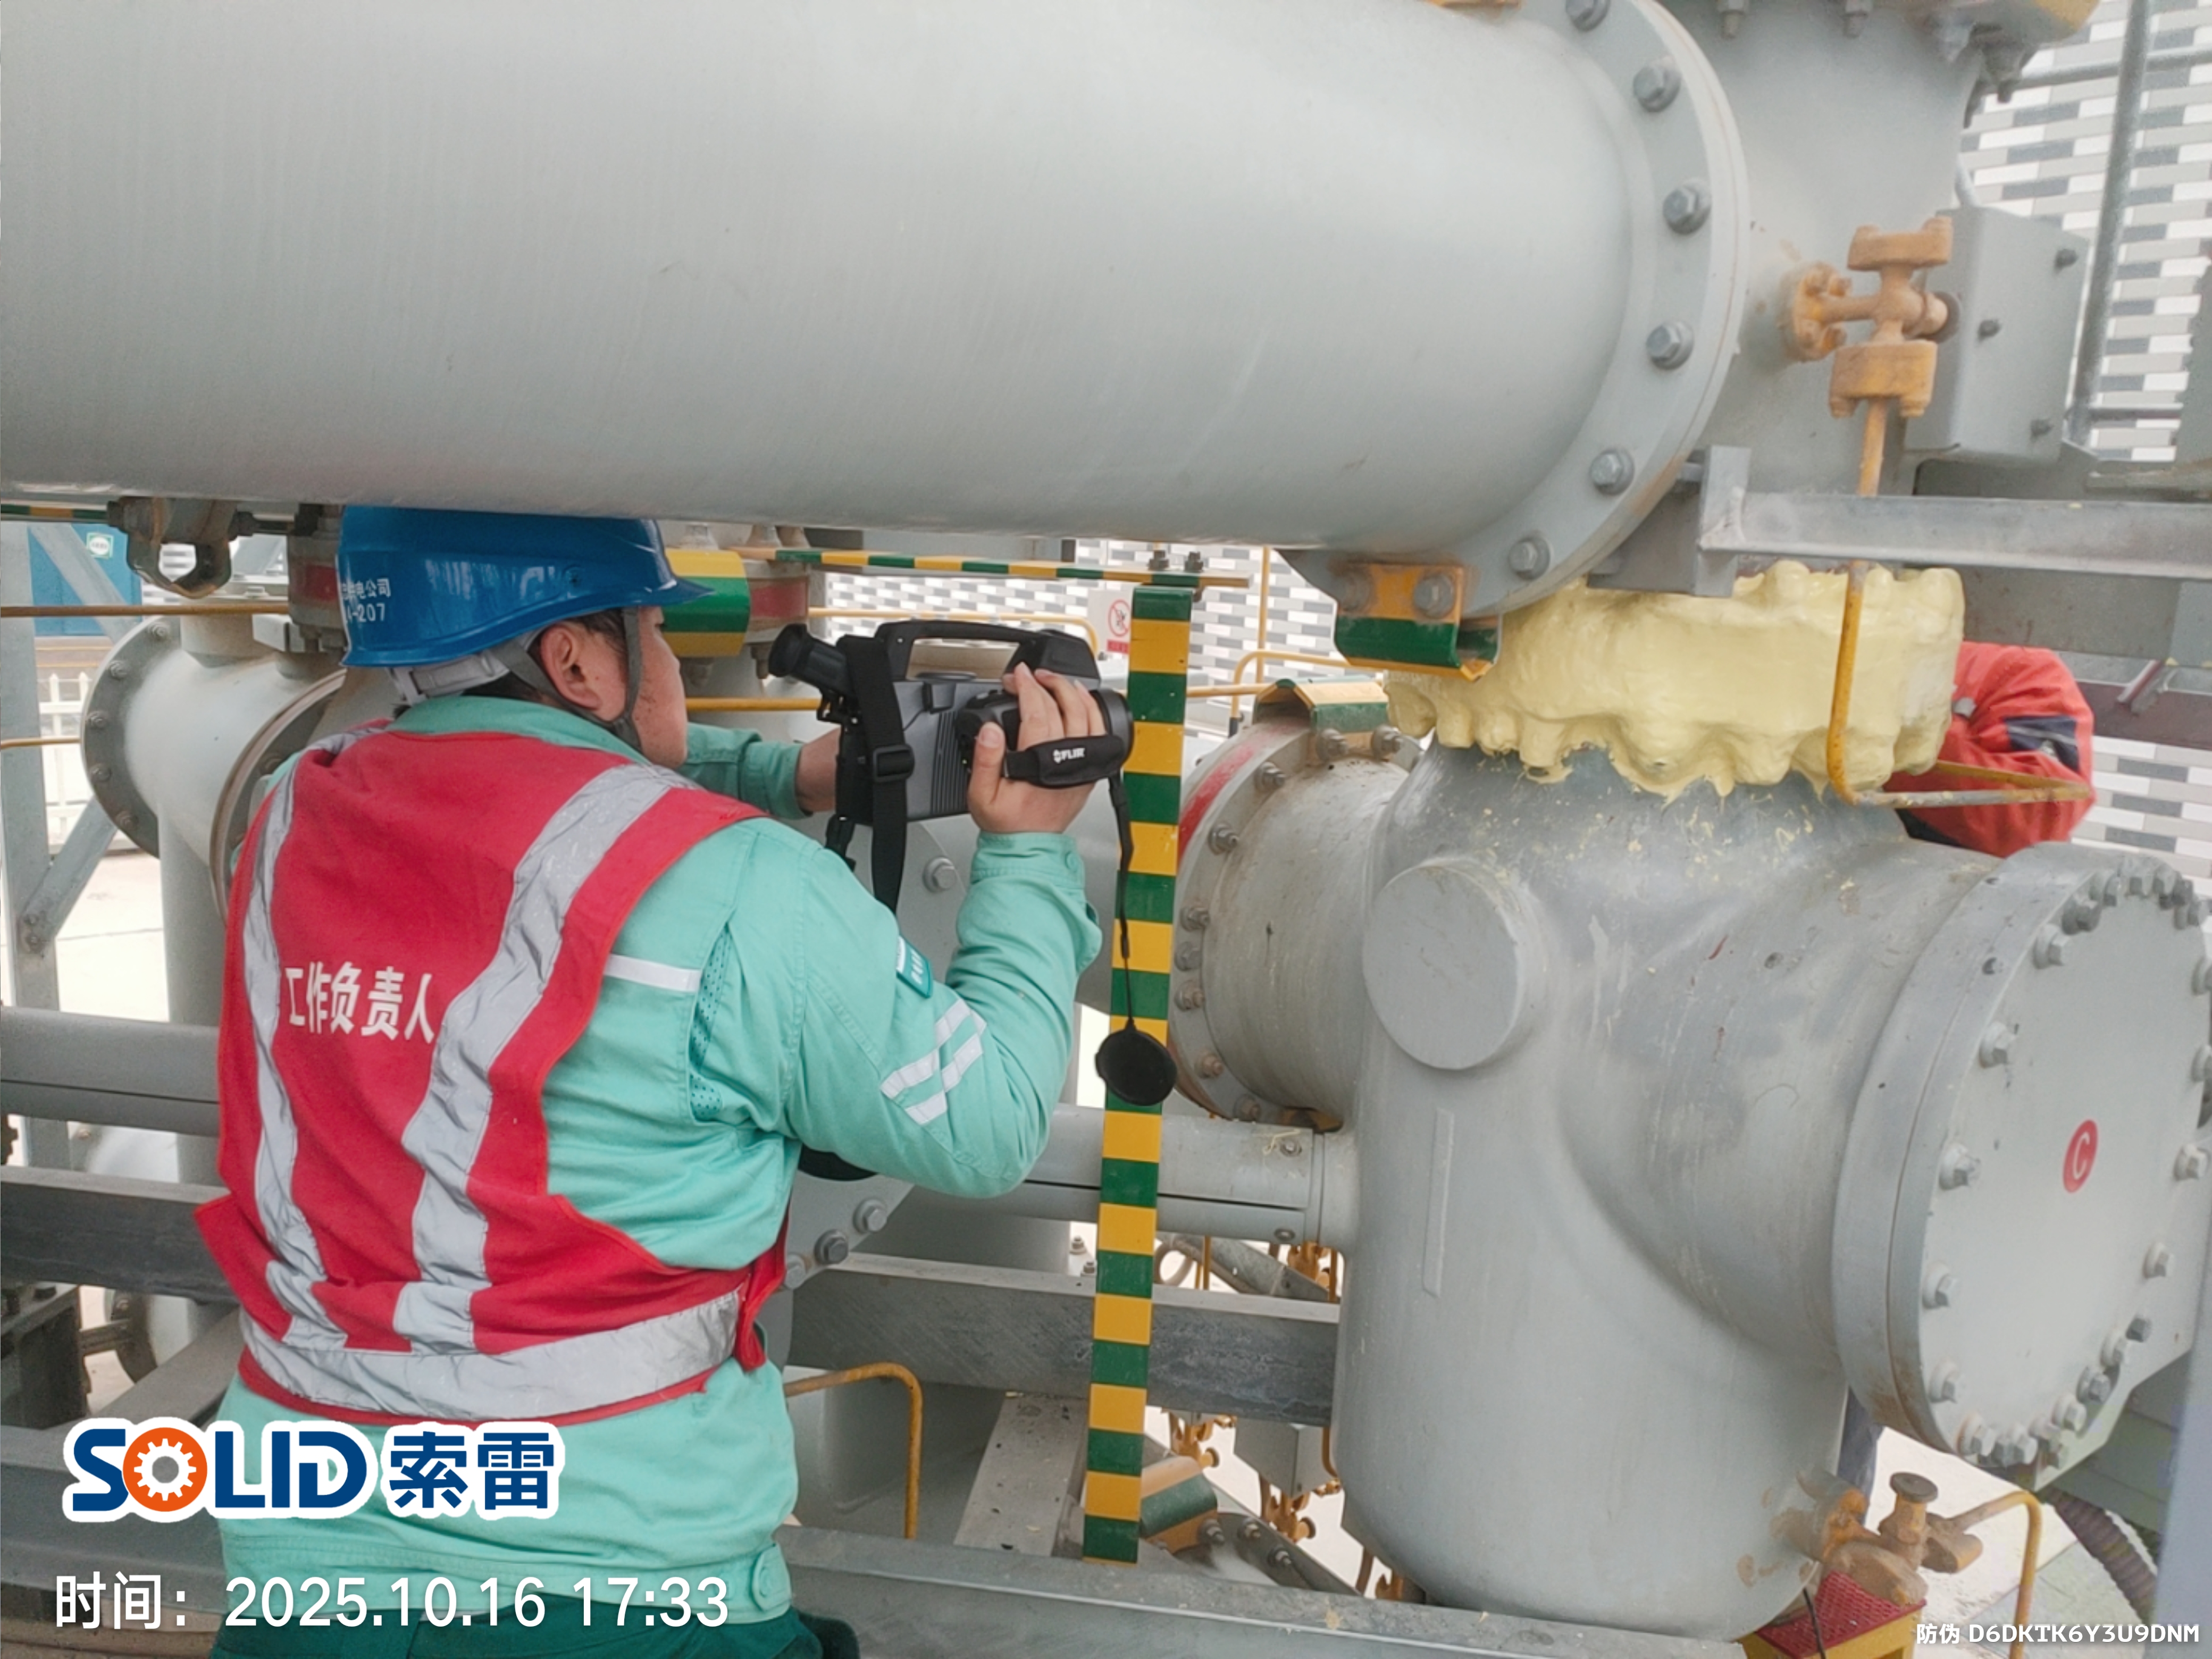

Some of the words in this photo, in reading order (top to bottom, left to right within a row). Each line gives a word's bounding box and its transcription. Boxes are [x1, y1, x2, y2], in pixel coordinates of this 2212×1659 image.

[285, 961, 435, 1044] 工作负责人
[2073, 1131, 2090, 1180] C
